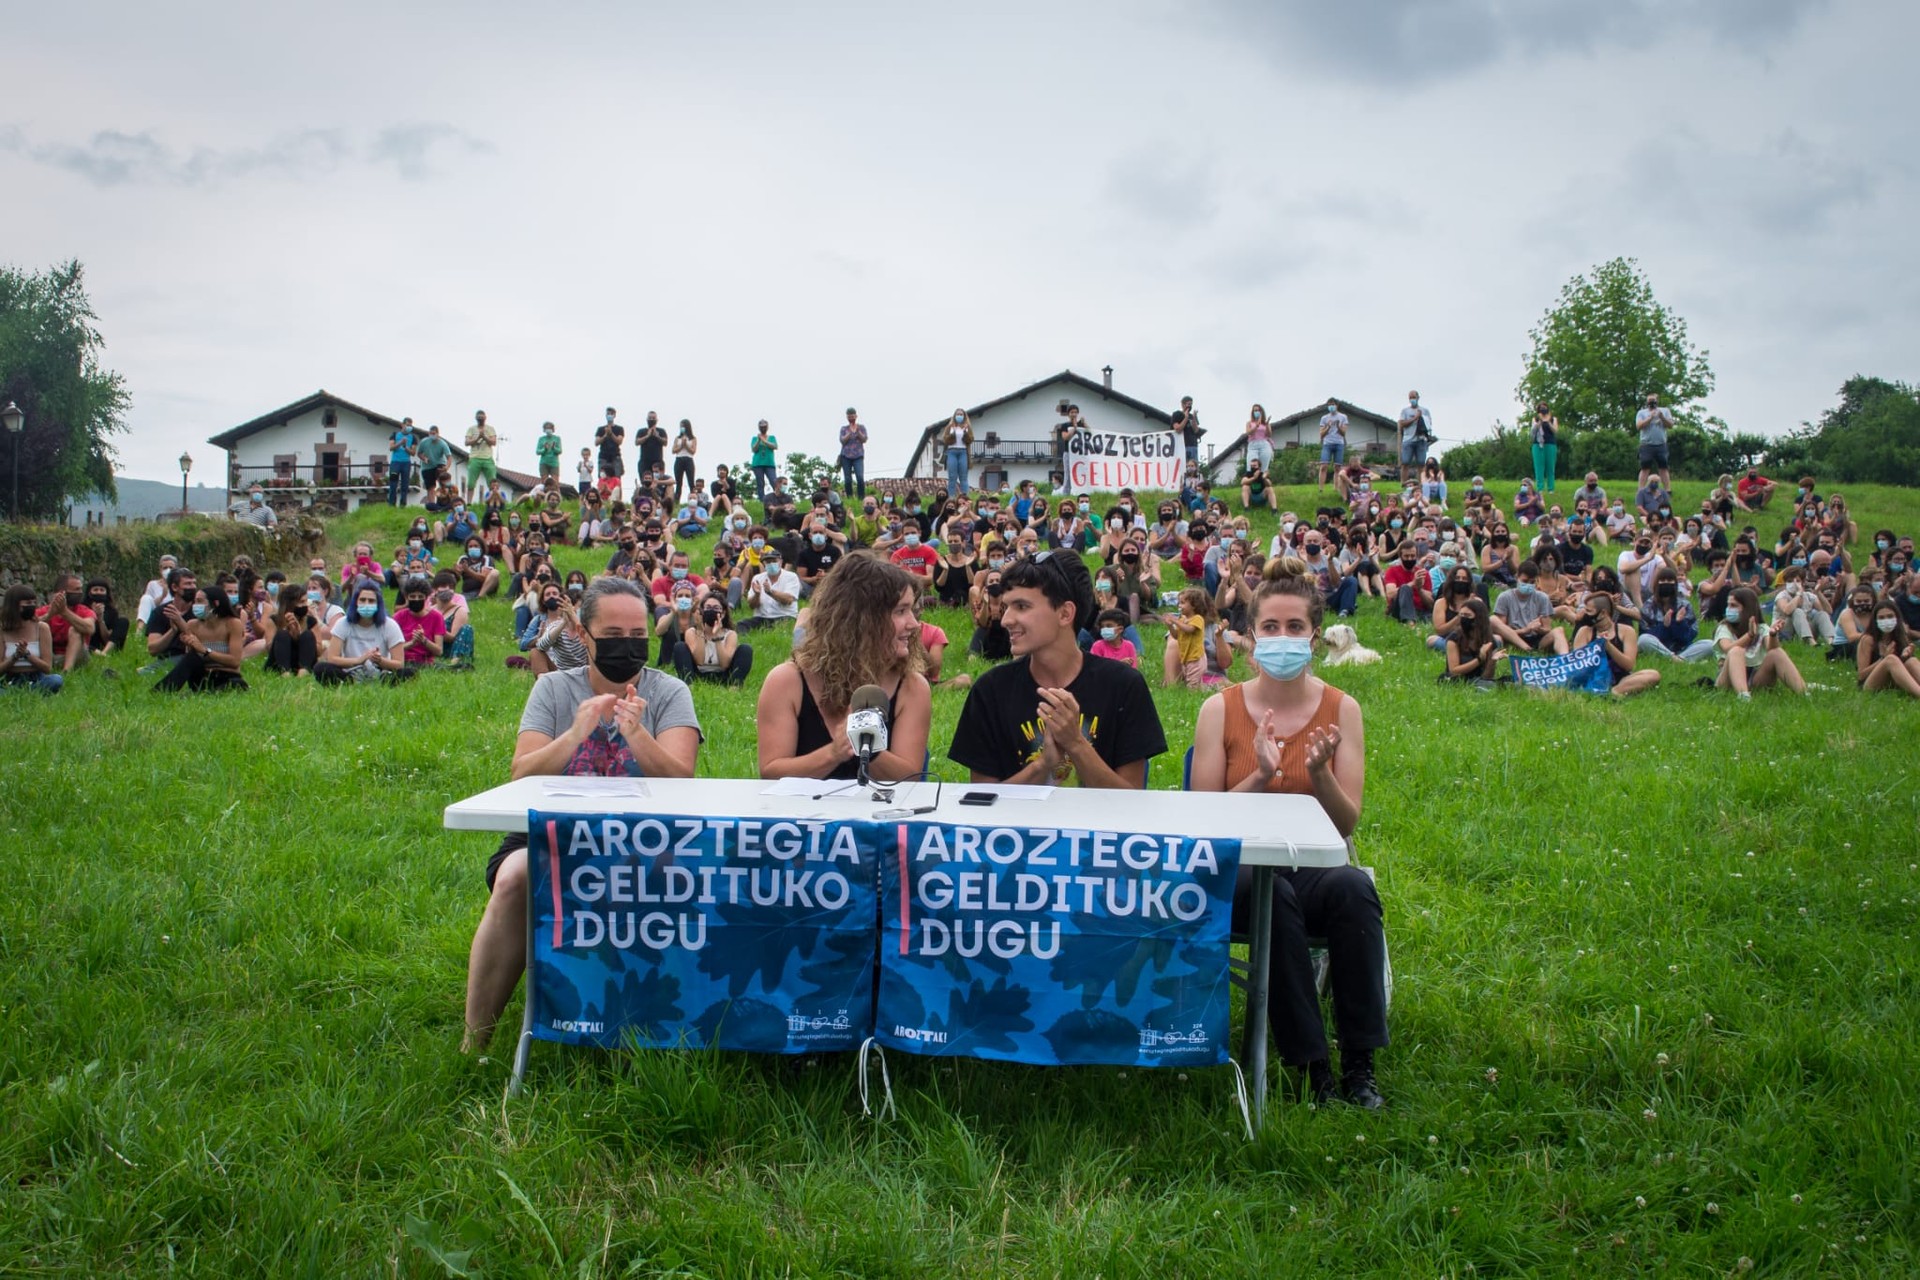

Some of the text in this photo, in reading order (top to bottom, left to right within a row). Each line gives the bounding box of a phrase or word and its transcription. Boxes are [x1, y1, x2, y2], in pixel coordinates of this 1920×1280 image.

[1520, 643, 1602, 670] AROZTEGIA
[1522, 654, 1601, 682] GELDITUKO
[568, 819, 860, 865] AROZTEGIA
[916, 826, 1219, 875] AROZTEGIA
[570, 865, 850, 910] GELDITUKO
[917, 871, 1208, 922] GELDITUKO
[573, 910, 707, 951] DUGU
[919, 919, 1061, 960] DUGU
[552, 1018, 604, 1033] AROZTAK!
[893, 1024, 948, 1043] AROZTAK!
